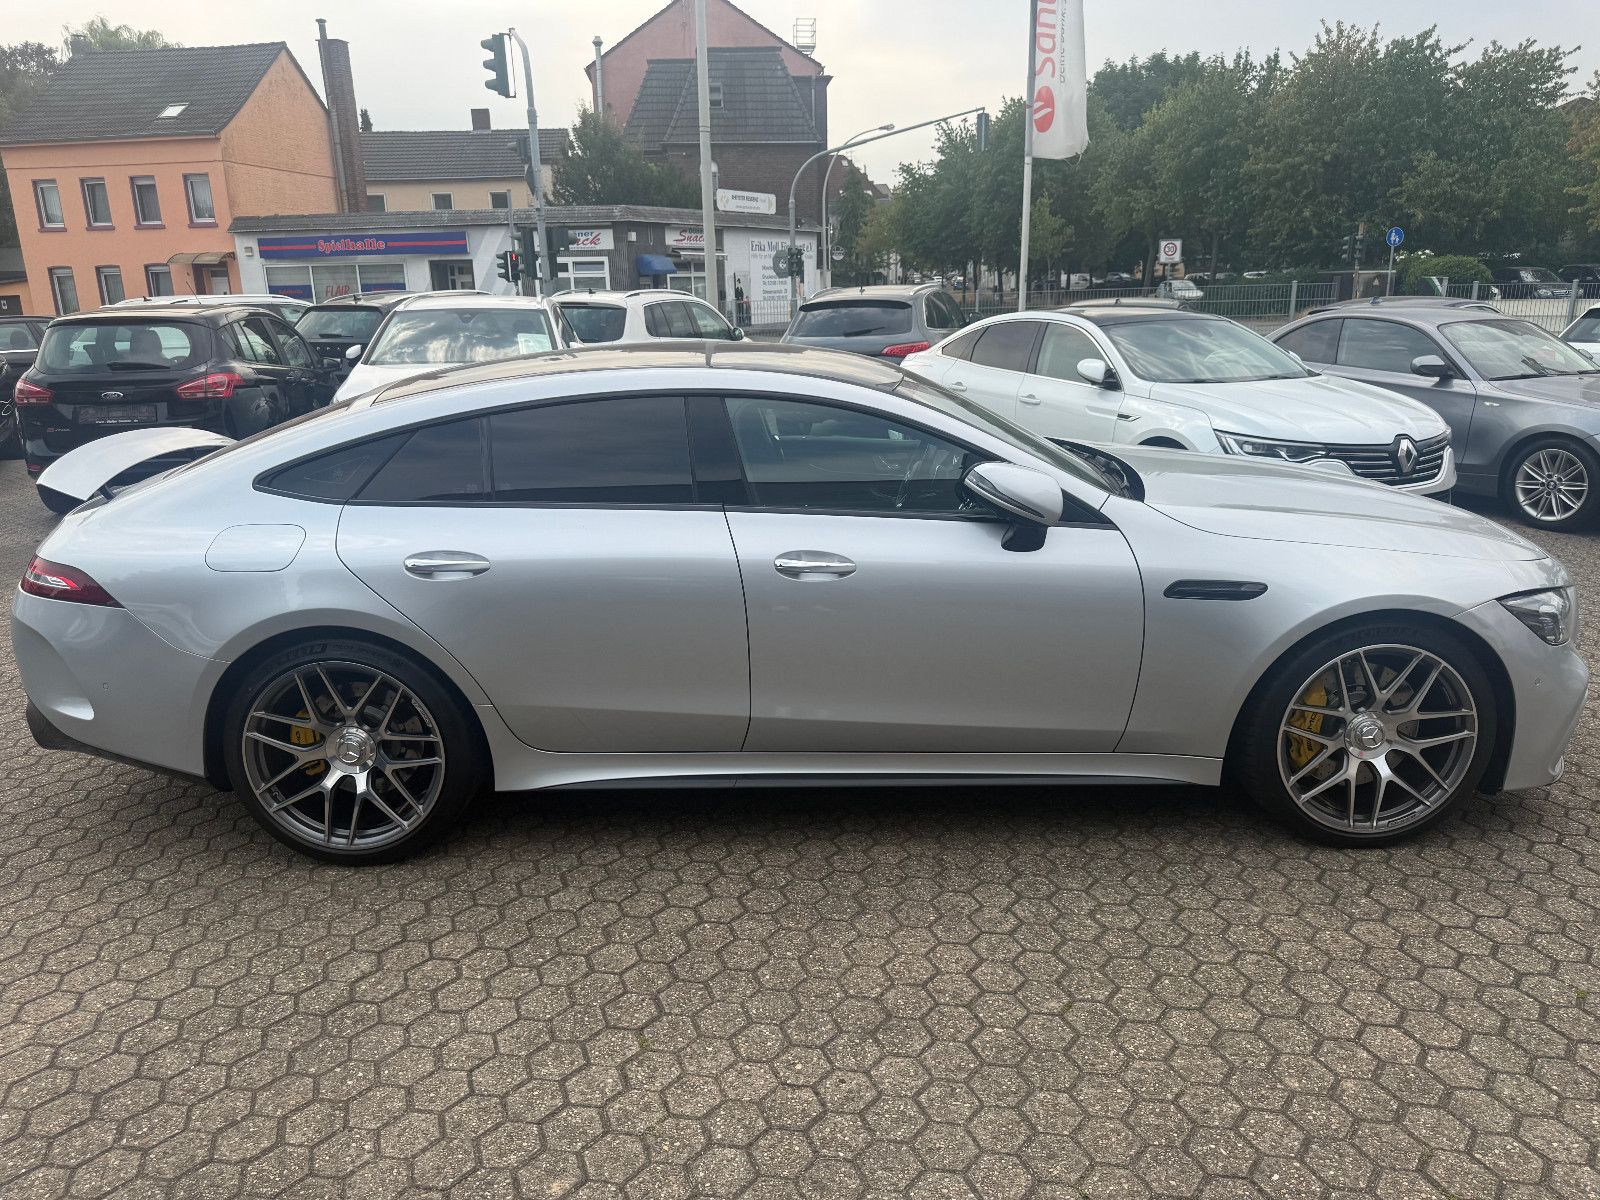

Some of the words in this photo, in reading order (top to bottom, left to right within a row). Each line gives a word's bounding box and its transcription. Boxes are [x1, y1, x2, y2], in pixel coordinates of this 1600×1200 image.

[1035, 0, 1057, 78] San
[674, 229, 705, 242] Snac
[318, 239, 385, 253] Spielhalle
[1166, 245, 1175, 253] 30
